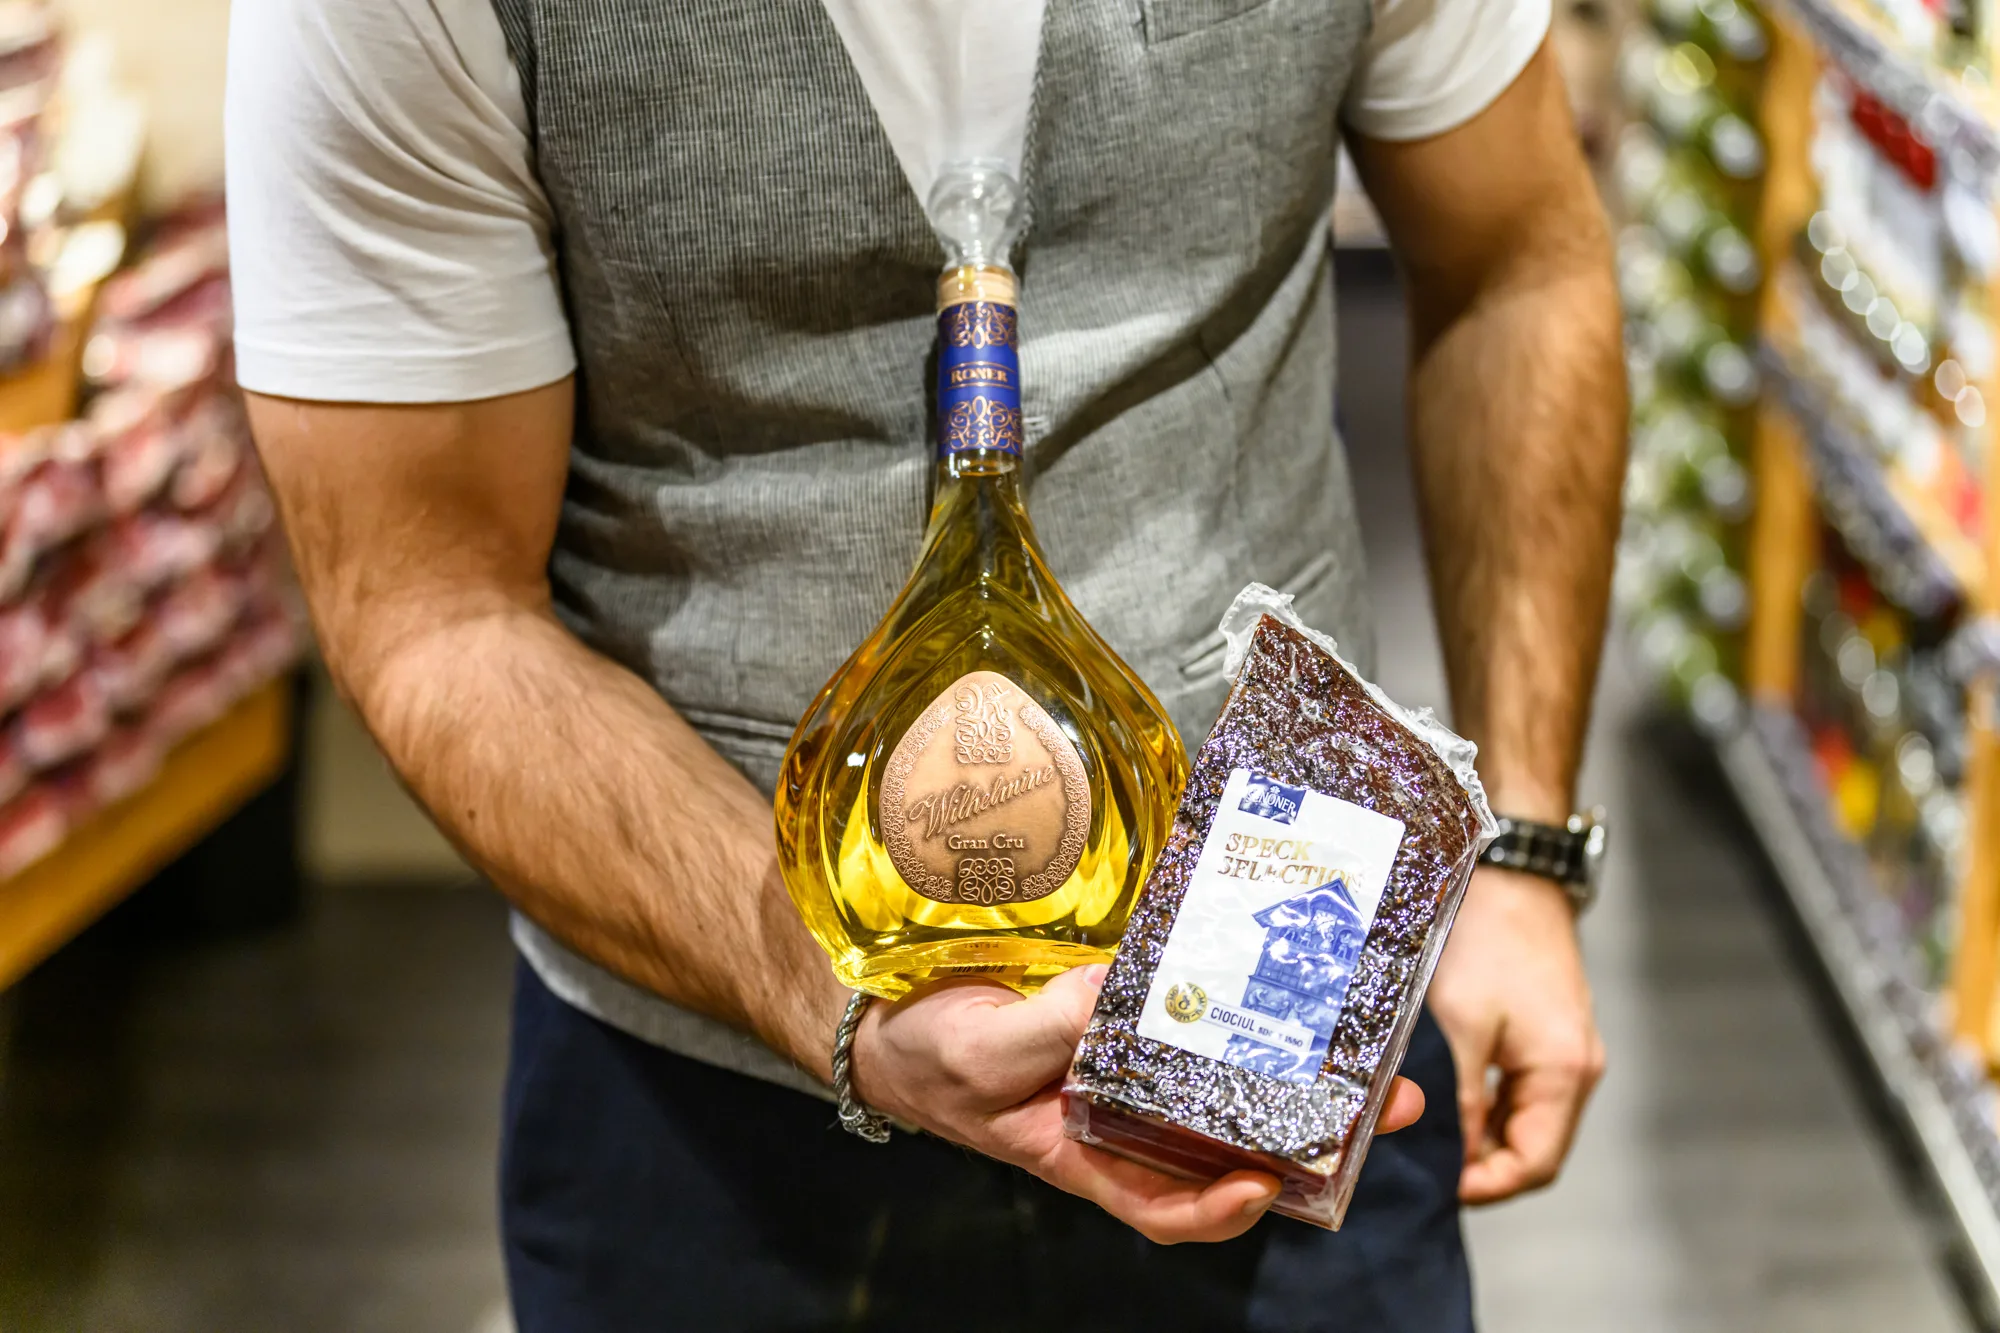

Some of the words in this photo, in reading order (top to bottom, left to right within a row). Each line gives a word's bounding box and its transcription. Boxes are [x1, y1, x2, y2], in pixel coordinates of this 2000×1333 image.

[951, 367, 1008, 384] RONER
[908, 765, 1054, 840] Wilhelmine
[1245, 787, 1297, 816] NONER
[948, 834, 988, 850] Gran
[992, 833, 1025, 850] Cru
[1225, 832, 1313, 861] SPECK
[1210, 1007, 1255, 1032] CIOCIUL
